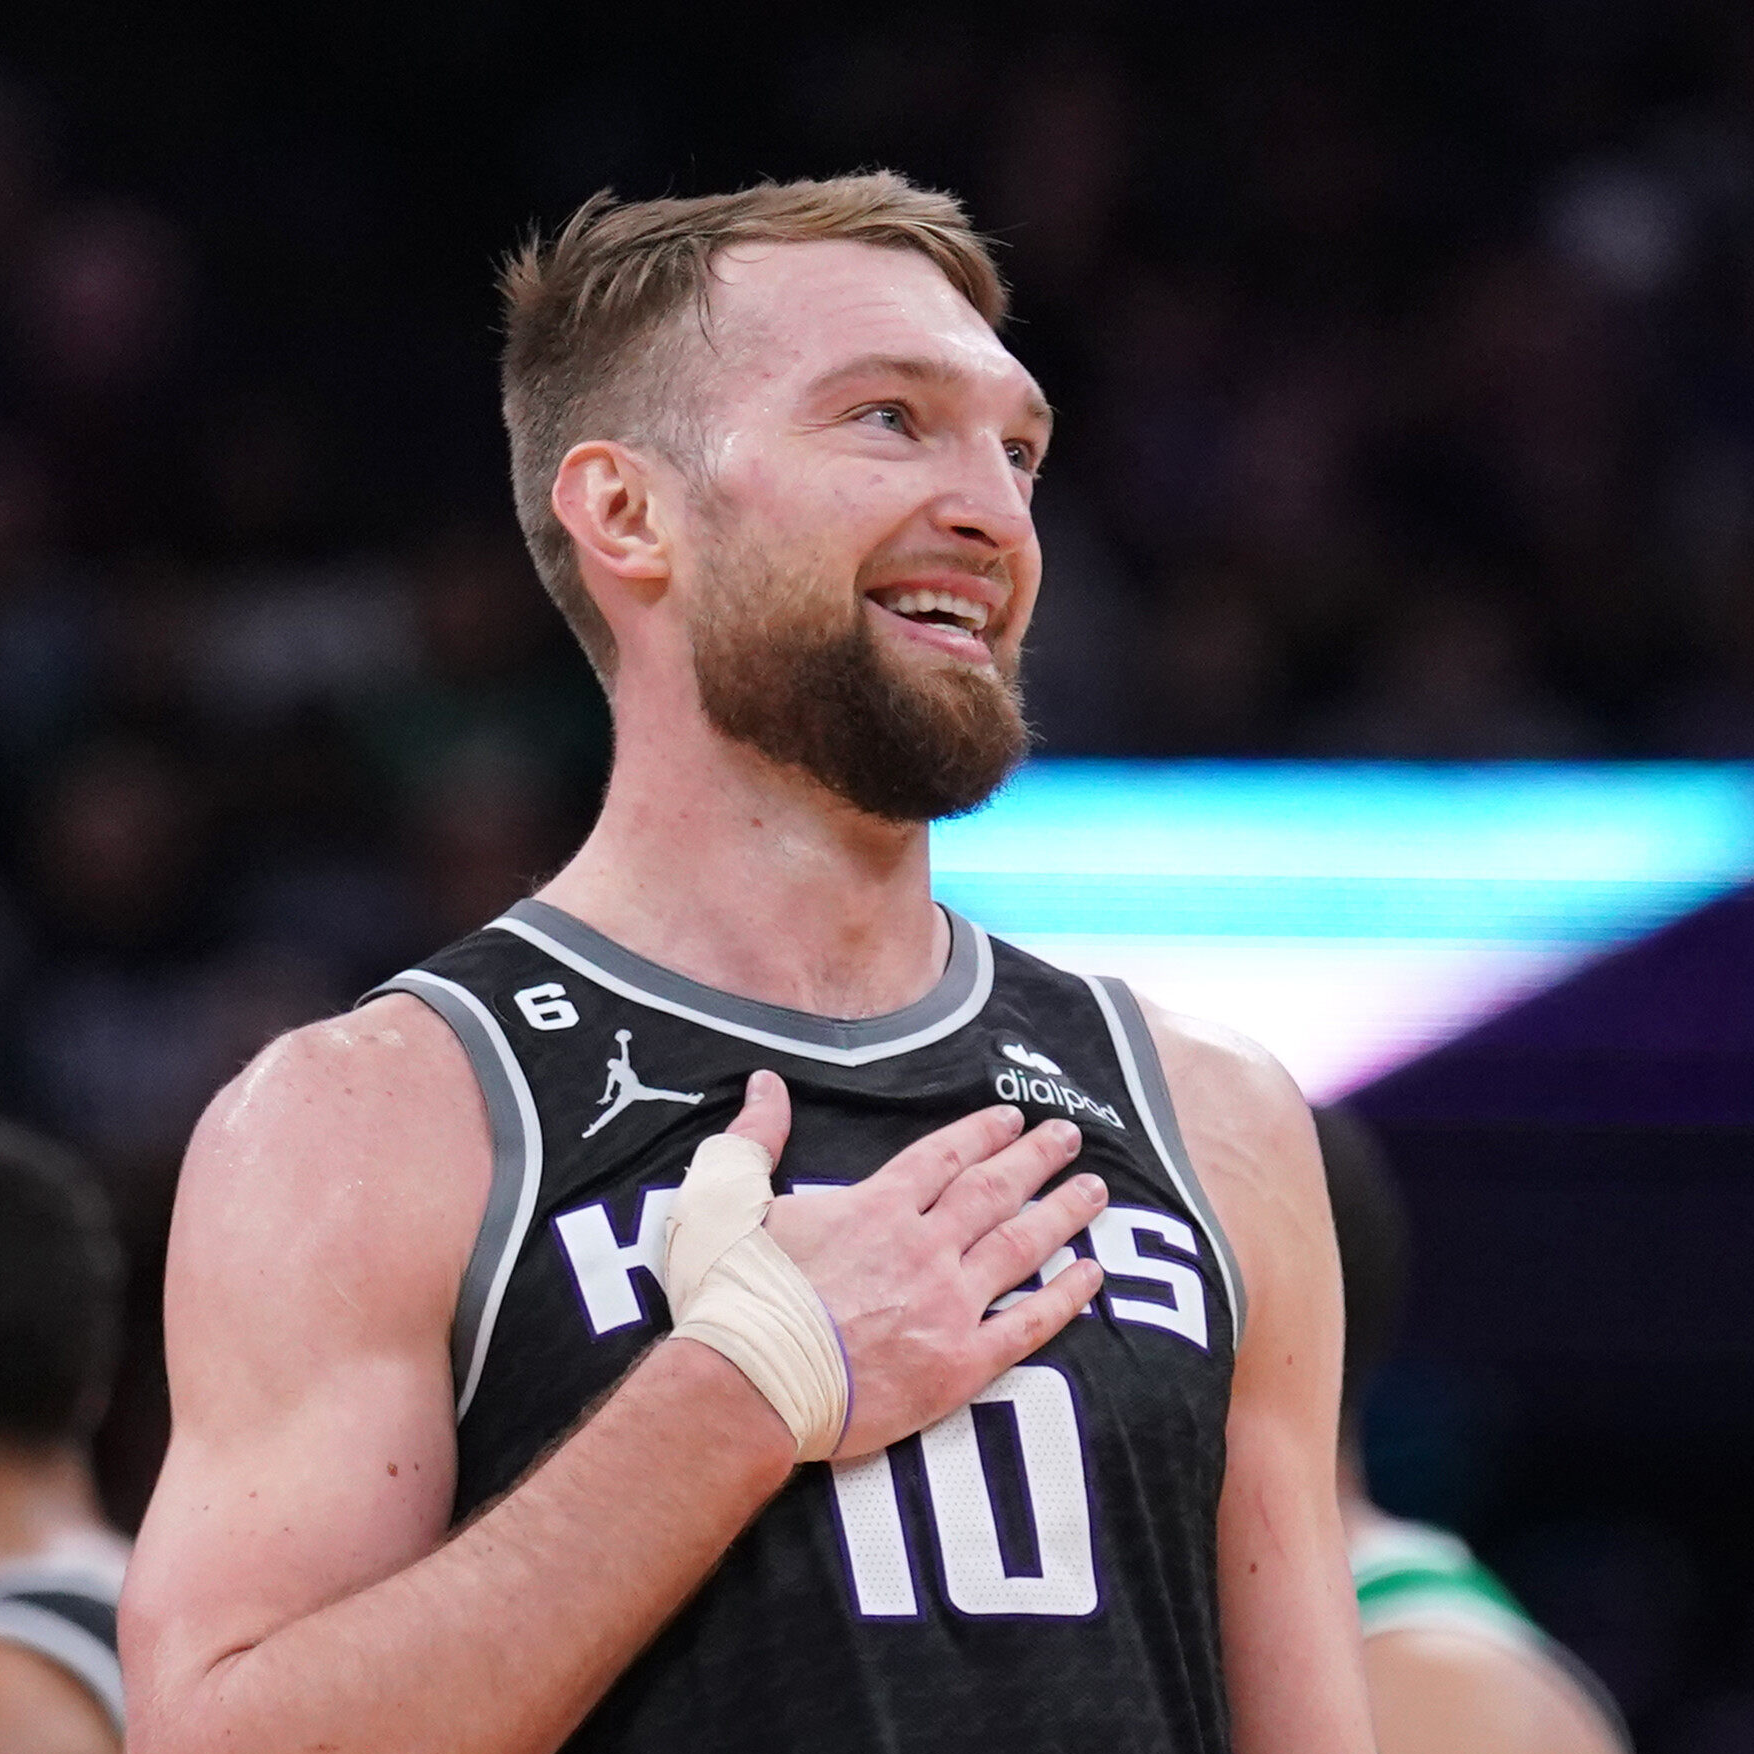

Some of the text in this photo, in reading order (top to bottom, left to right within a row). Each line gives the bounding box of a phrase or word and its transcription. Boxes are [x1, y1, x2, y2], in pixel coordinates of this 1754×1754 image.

[513, 982, 580, 1032] 6
[996, 1069, 1126, 1130] dialpad
[831, 1366, 1099, 1615] 10
